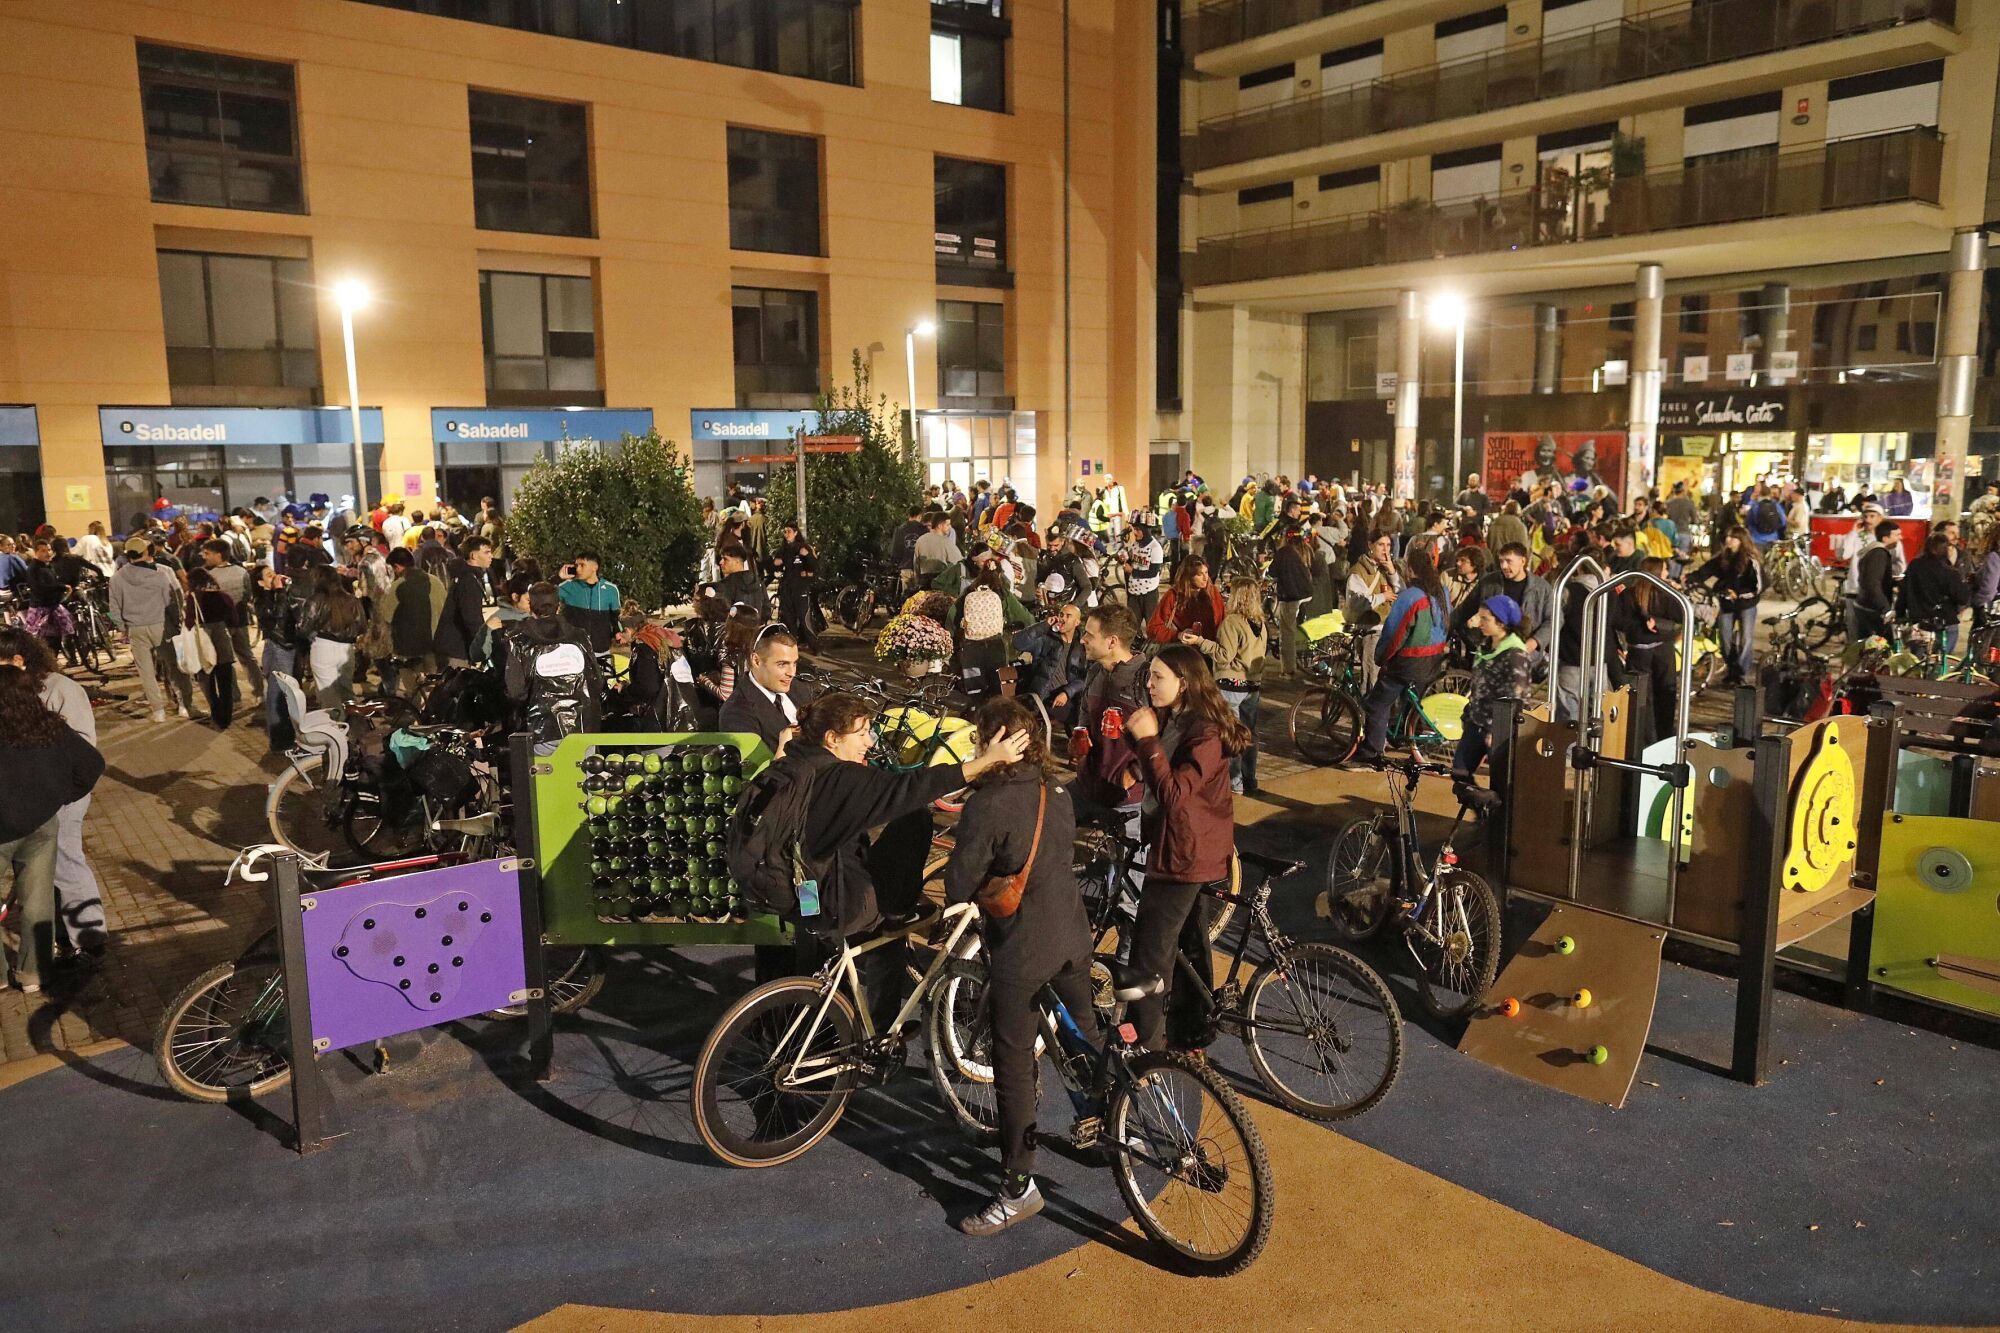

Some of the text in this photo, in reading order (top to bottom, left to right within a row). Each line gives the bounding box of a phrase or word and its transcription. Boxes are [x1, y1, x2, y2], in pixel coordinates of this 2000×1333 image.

[1381, 378, 1396, 387] SE
[1661, 402, 1688, 412] ENEU
[1660, 415, 1690, 425] PULAR
[136, 423, 225, 440] Sabadell
[458, 422, 528, 438] Sabadell
[711, 422, 769, 436] Sabadell
